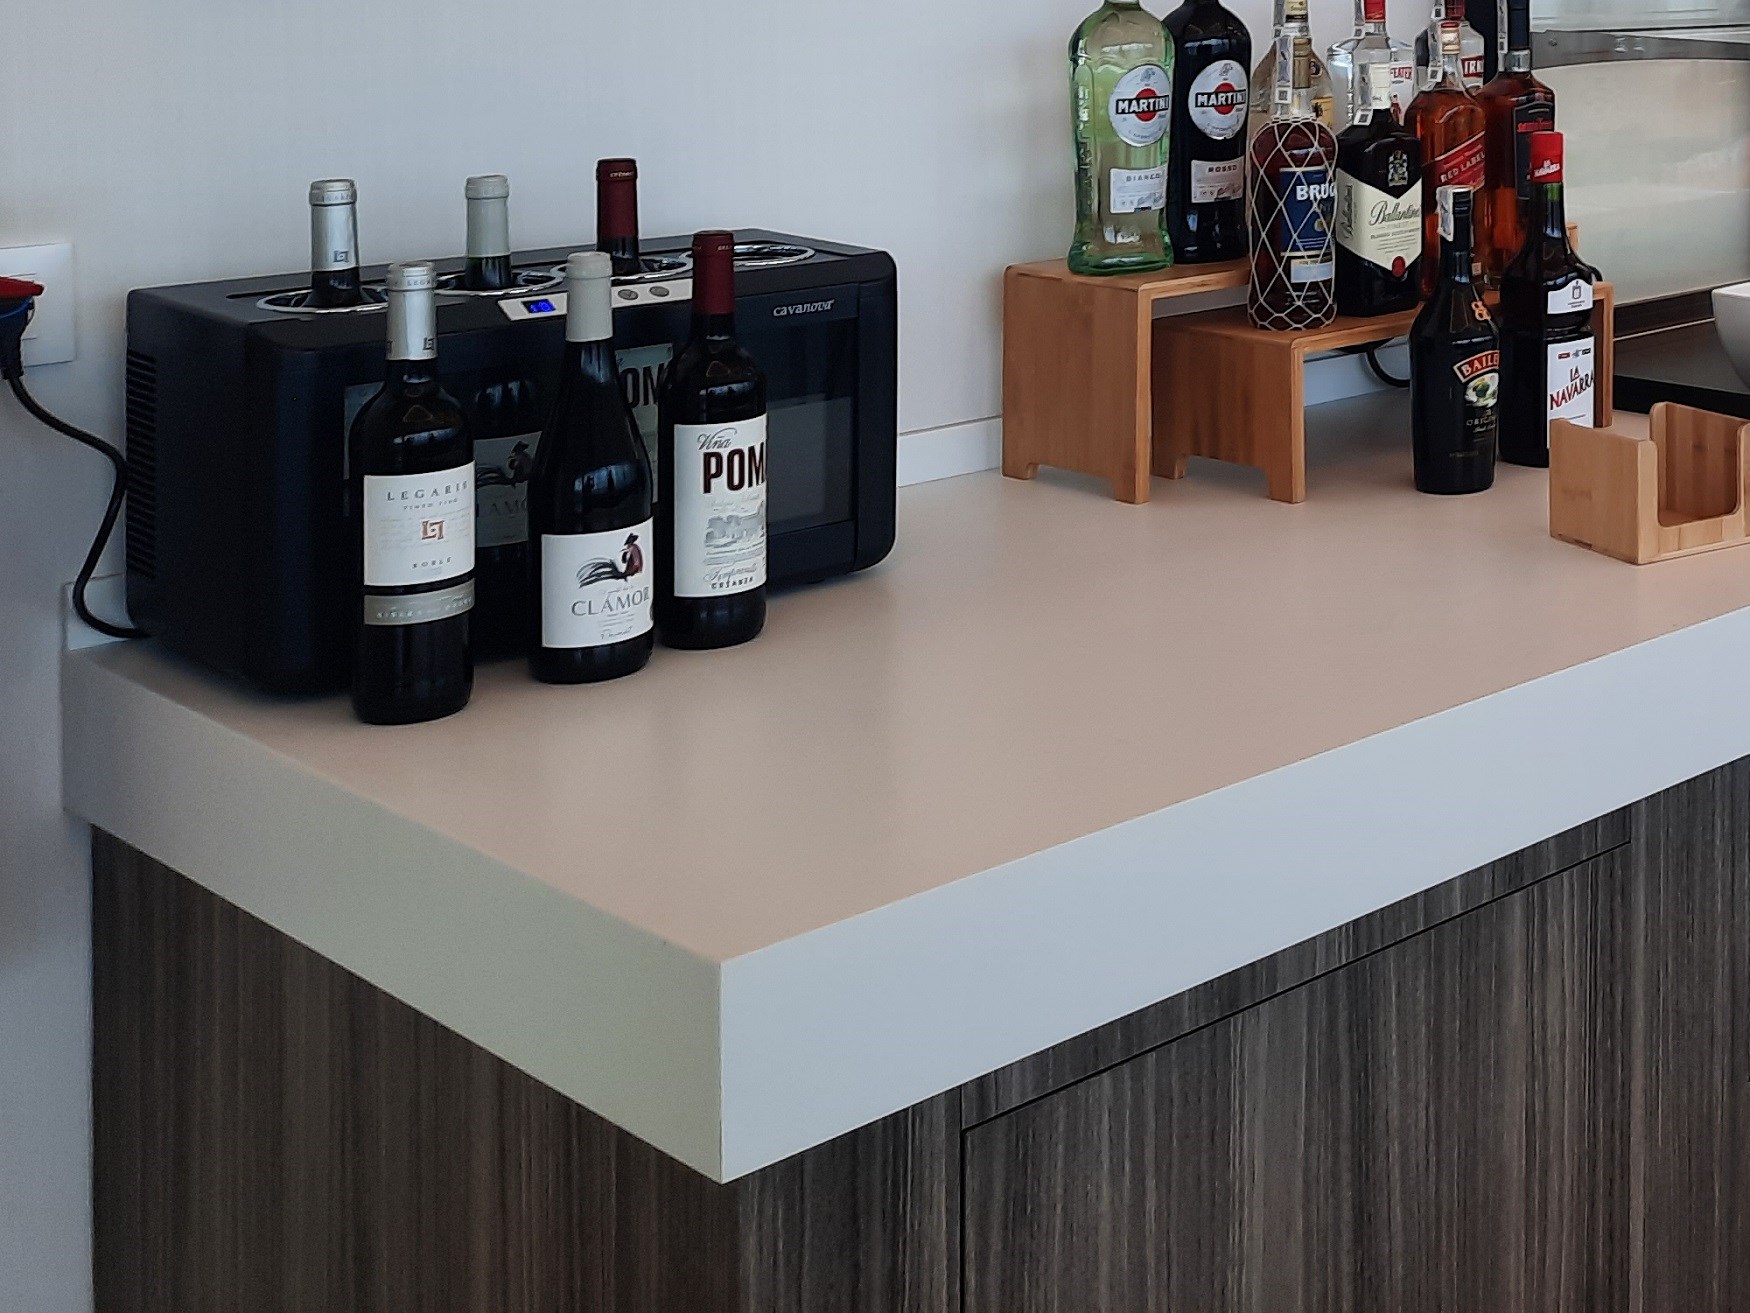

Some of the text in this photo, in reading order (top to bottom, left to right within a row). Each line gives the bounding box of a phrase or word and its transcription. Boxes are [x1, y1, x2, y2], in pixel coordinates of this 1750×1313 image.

[1117, 95, 1169, 113] MARTINI
[1197, 89, 1247, 107] MARTINI
[1207, 164, 1238, 173] ROSSO
[1440, 168, 1459, 183] RED
[1460, 151, 1485, 172] LABEL
[1126, 173, 1161, 182] BIANCO
[773, 299, 835, 317] cavanova
[1570, 365, 1580, 382] LA
[697, 427, 738, 451] Viña
